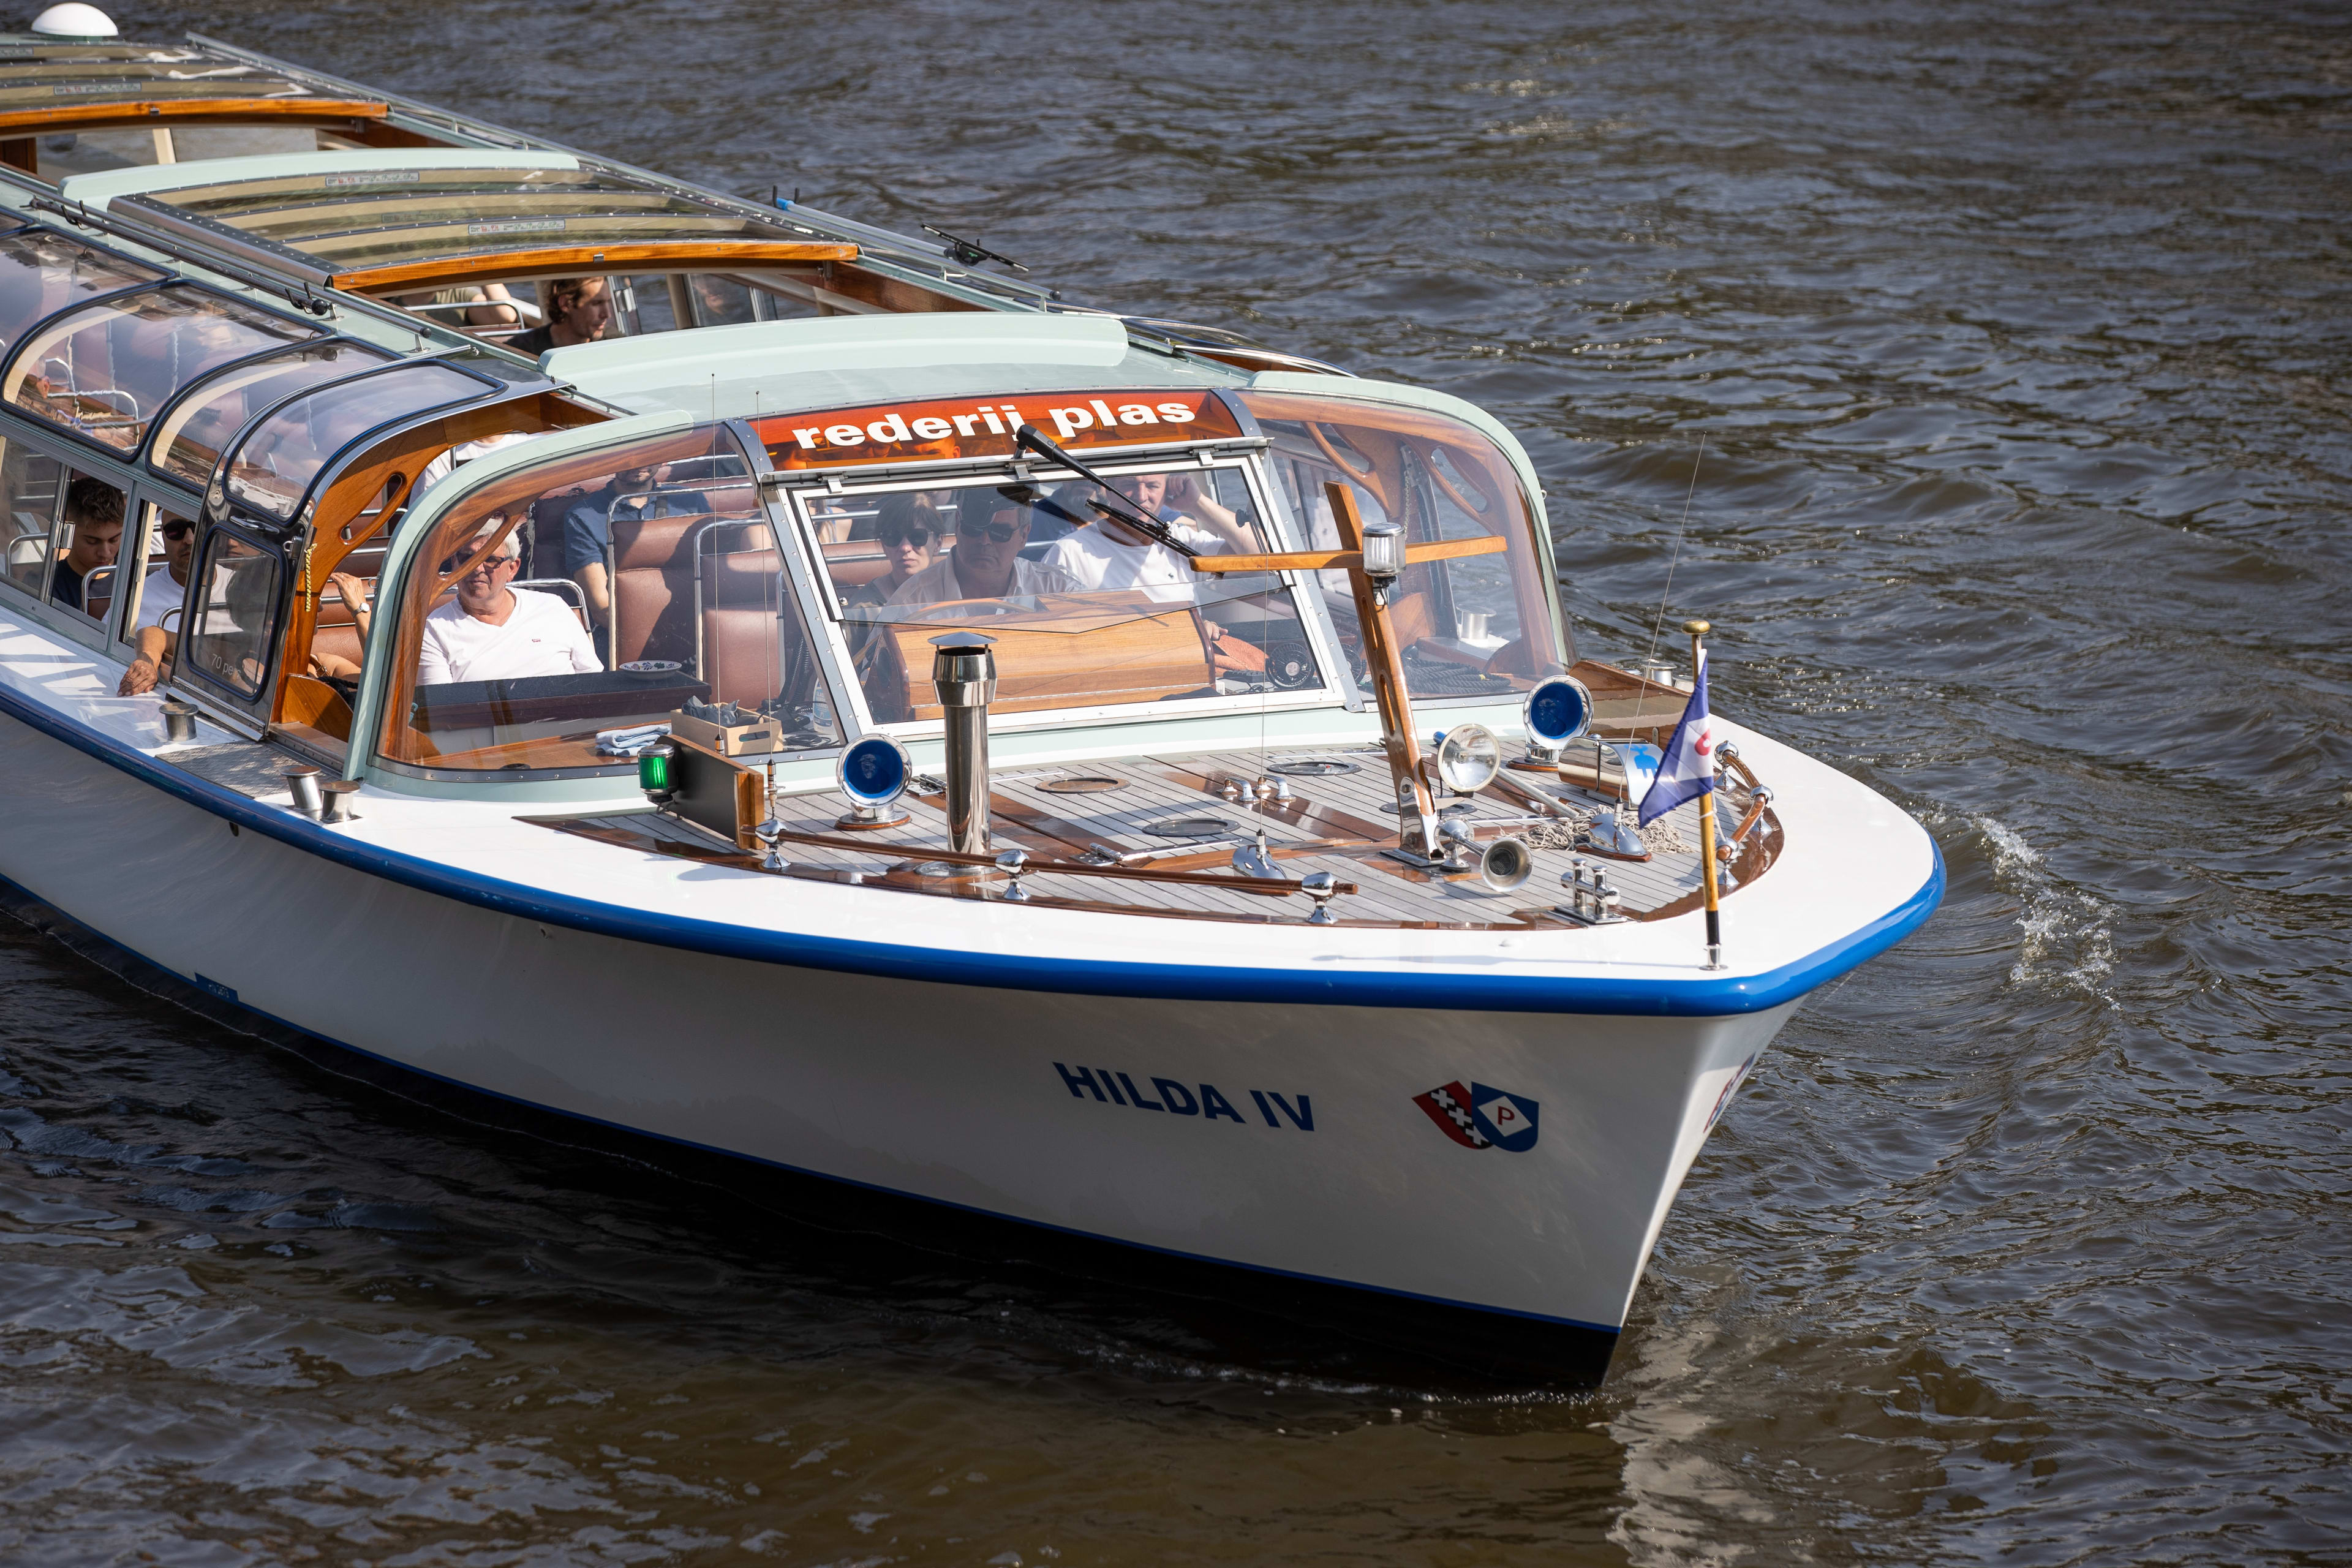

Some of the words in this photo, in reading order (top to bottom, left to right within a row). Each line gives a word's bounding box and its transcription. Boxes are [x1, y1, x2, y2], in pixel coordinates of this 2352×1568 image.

[791, 404, 1027, 450] rederij
[1048, 399, 1196, 438] plas
[211, 653, 222, 669] 70
[1052, 1061, 1246, 1124] HILDA
[1249, 1090, 1315, 1132] IV
[1498, 1105, 1515, 1126] P
